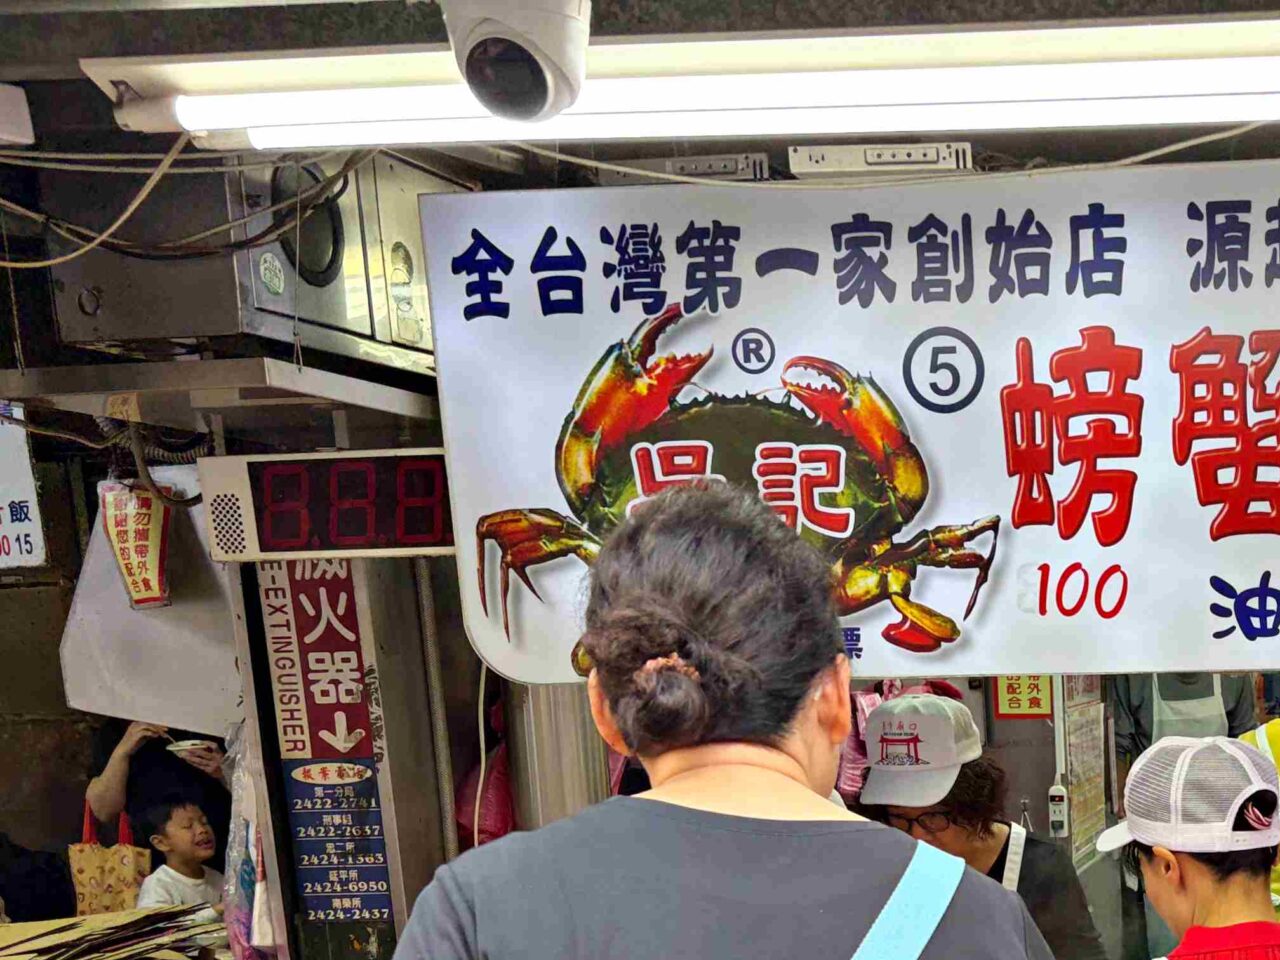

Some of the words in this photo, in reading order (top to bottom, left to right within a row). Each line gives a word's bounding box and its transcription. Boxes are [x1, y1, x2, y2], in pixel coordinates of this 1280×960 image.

[451, 203, 1126, 320] 全台灣第一家創始店
[1036, 561, 1128, 619] 100
[303, 881, 387, 894] 2424-6950
